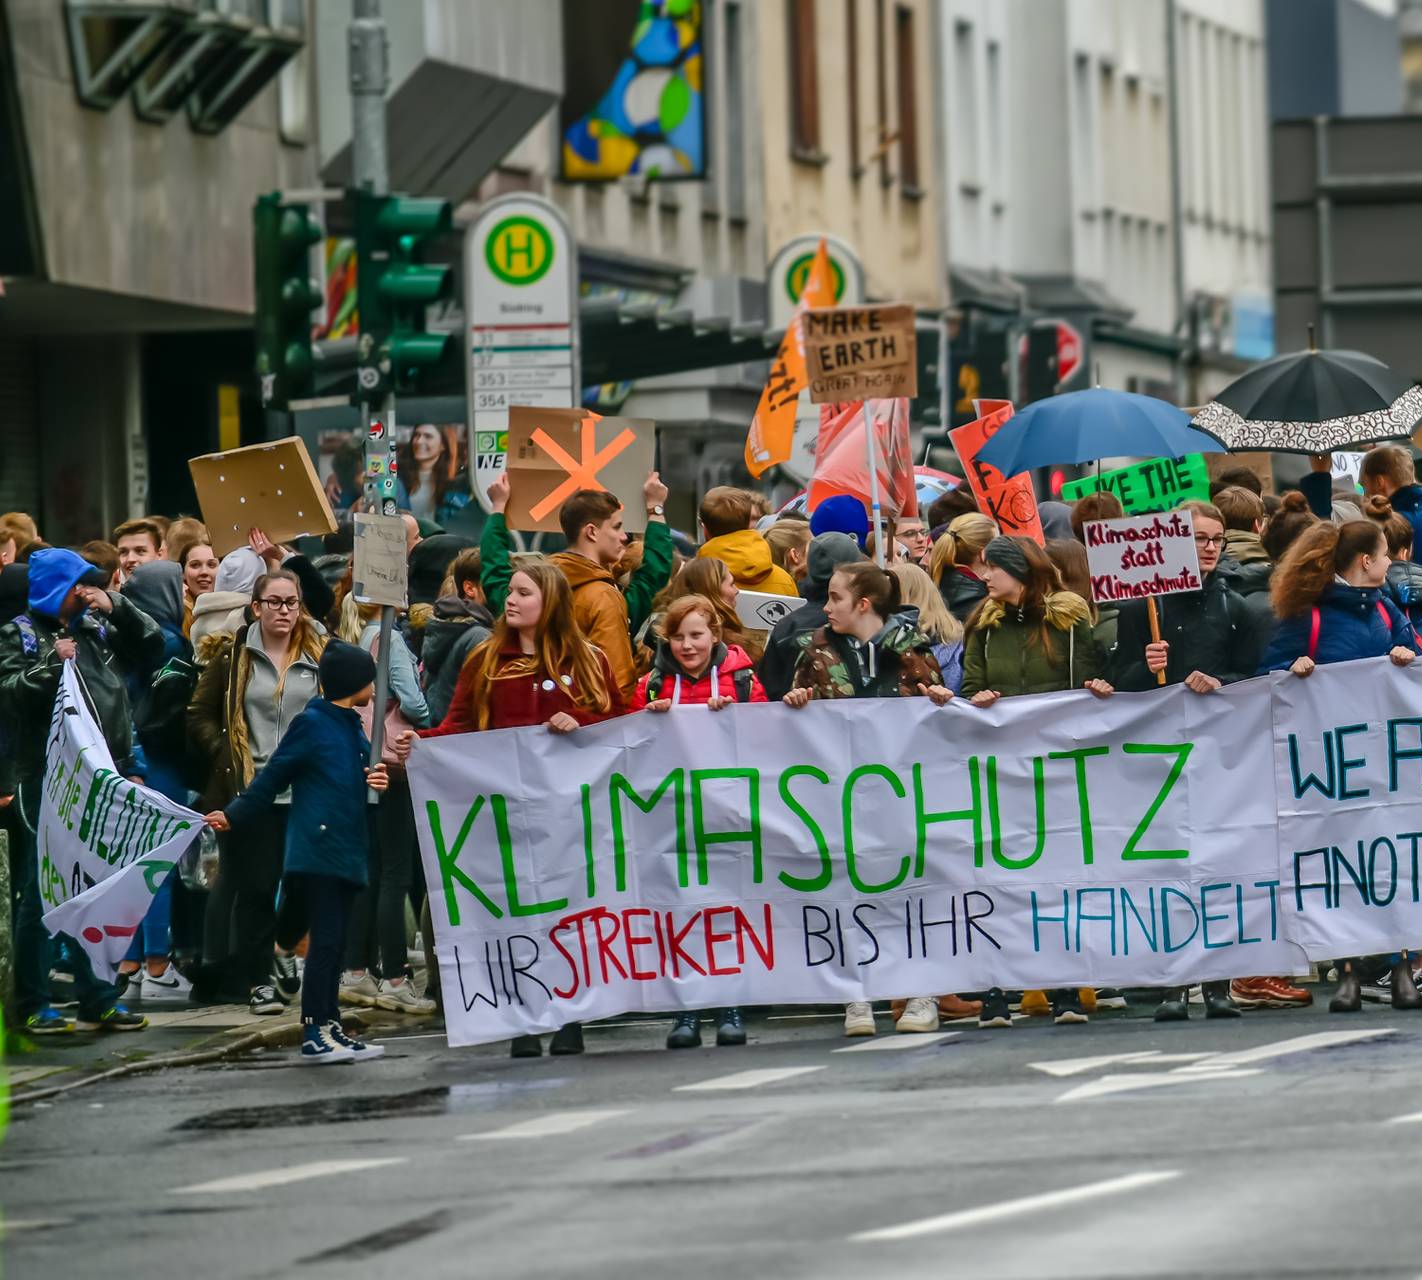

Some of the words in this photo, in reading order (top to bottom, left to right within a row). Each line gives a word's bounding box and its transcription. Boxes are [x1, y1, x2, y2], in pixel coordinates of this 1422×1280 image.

[807, 310, 883, 336] MAKE
[819, 335, 896, 372] EARTH
[1138, 457, 1194, 499] THE
[1086, 514, 1191, 548] Klimaschutz
[1121, 541, 1165, 570] statt
[1091, 566, 1200, 601] Klimaschmutz
[1288, 723, 1370, 800] WE
[426, 742, 1194, 926] KLIMASCHUTZ
[454, 934, 553, 1013] WIR
[548, 903, 774, 1000] STREIKEN
[803, 903, 879, 967] BIS
[906, 890, 1001, 959] IHR
[1031, 881, 1280, 956] HANDELT
